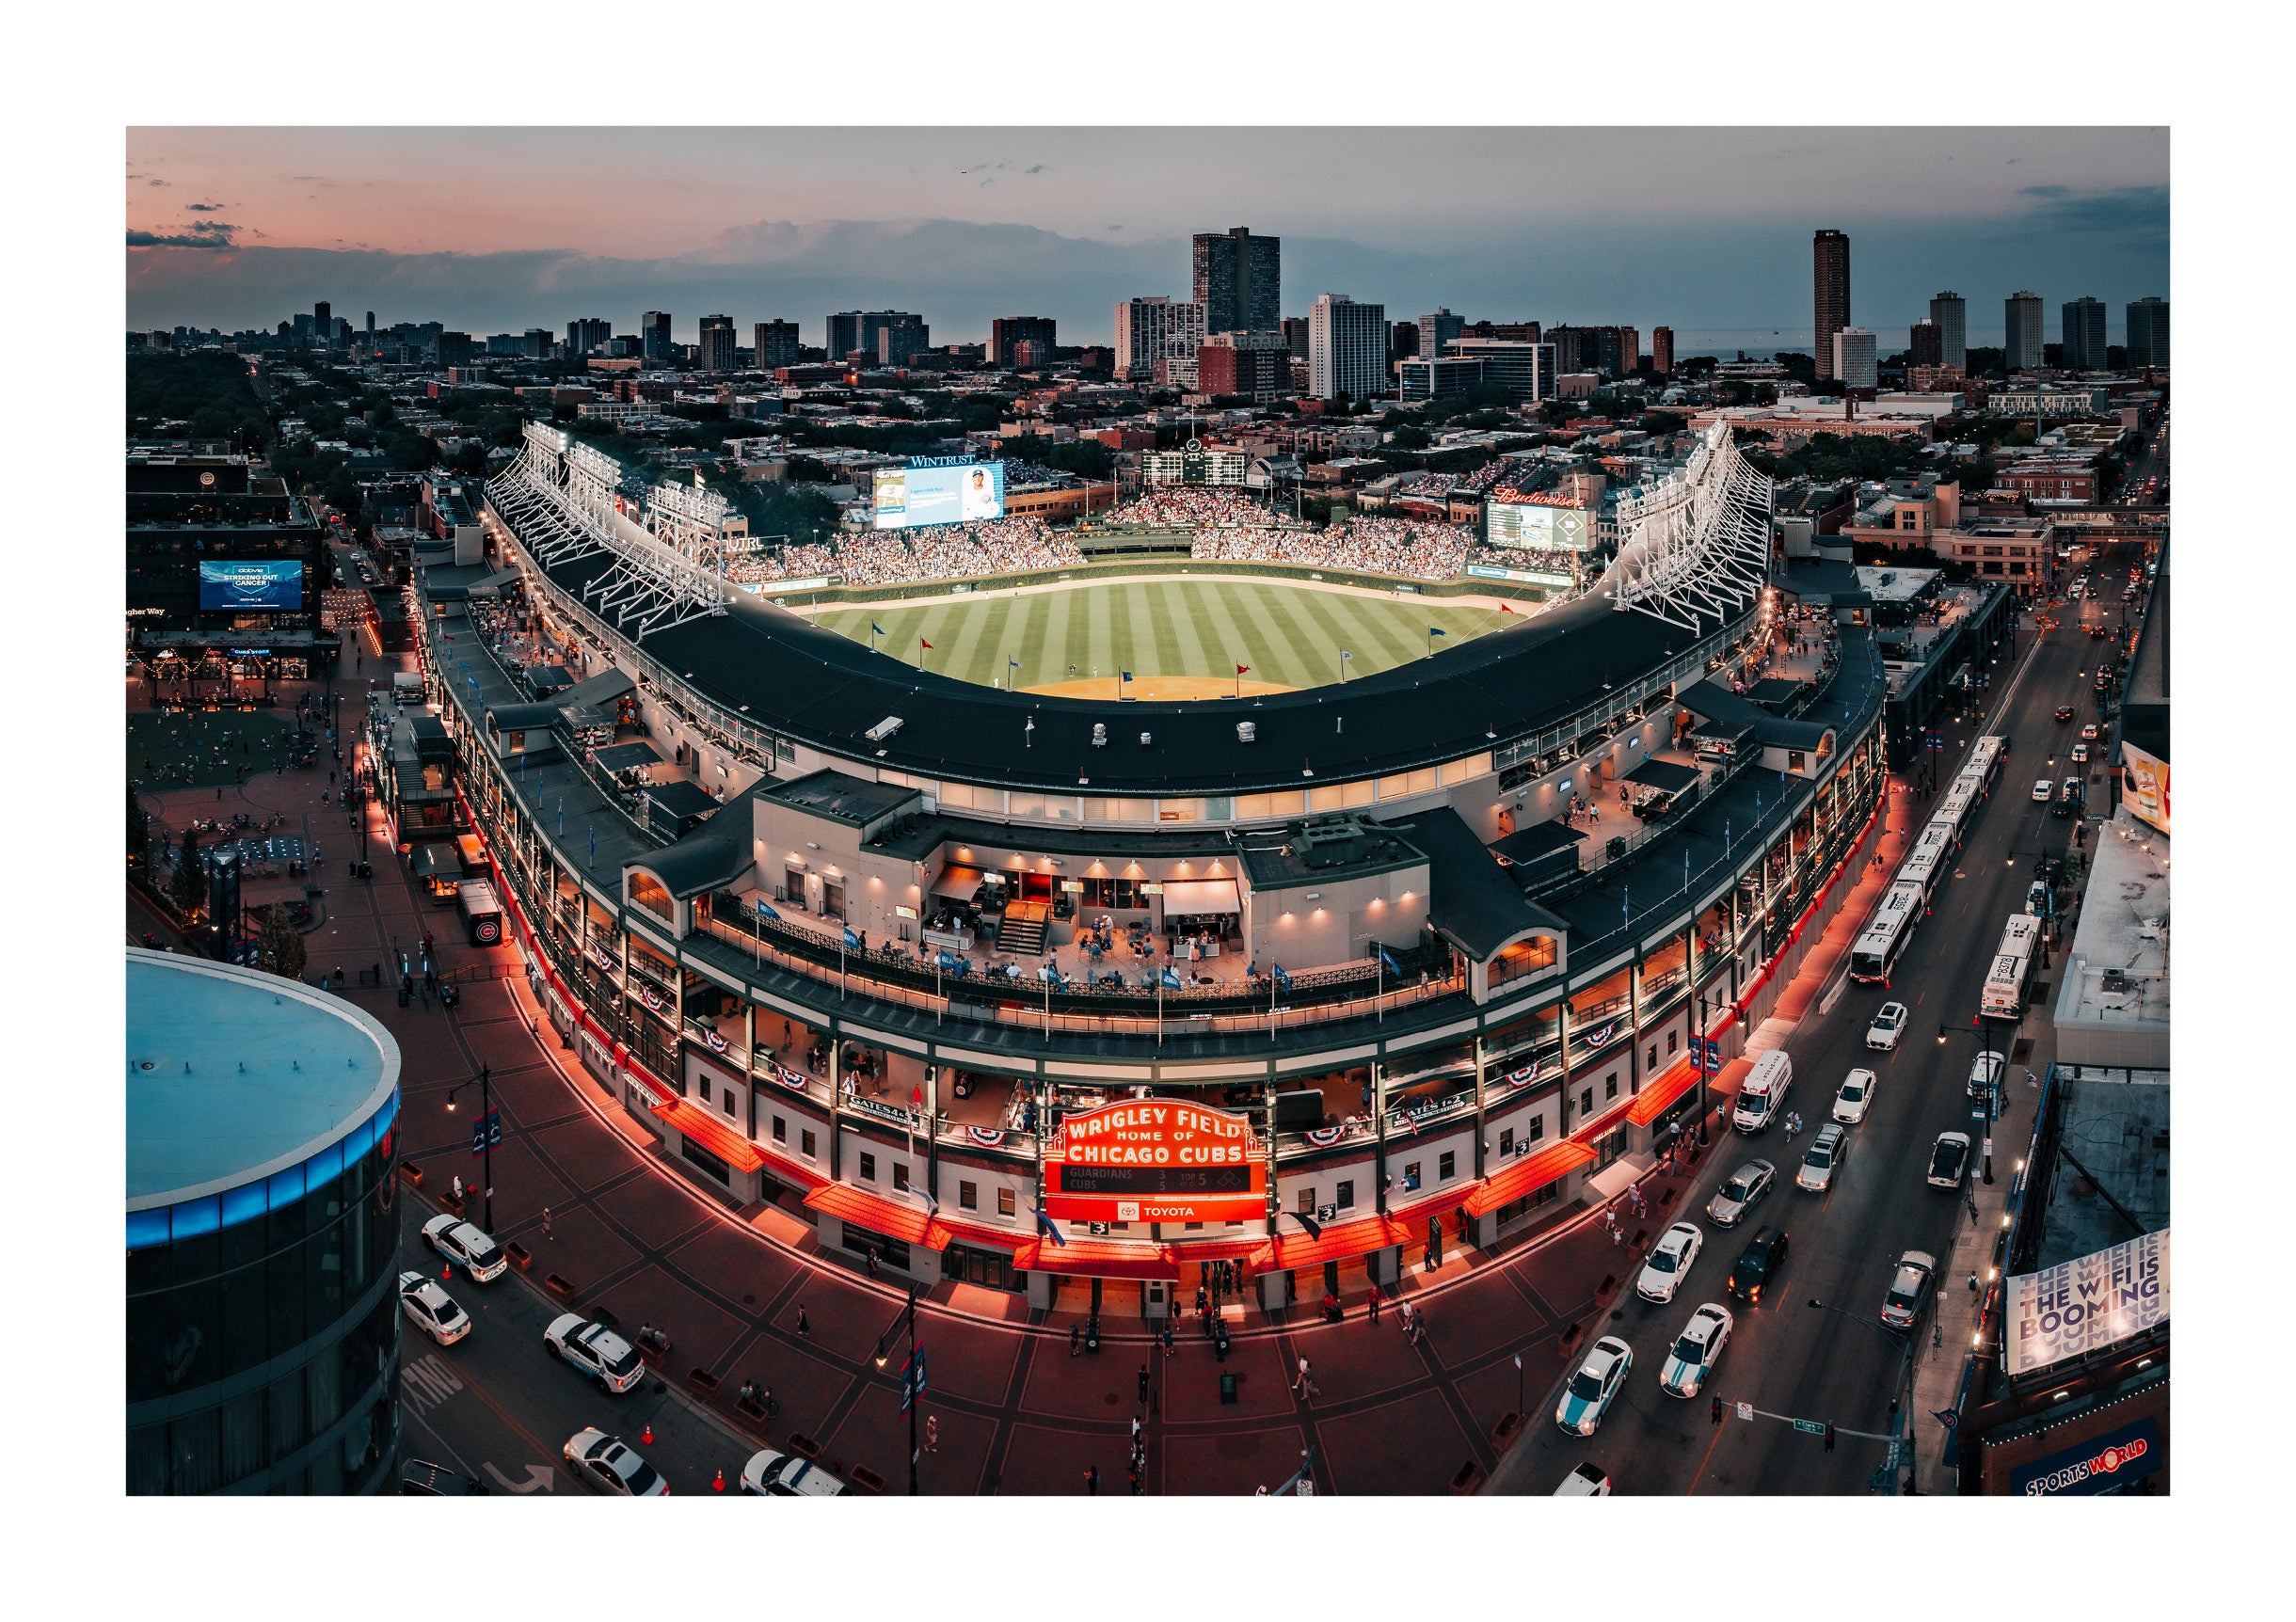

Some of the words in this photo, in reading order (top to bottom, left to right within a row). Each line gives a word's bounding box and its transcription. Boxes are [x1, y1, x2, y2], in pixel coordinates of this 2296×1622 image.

[1494, 487, 1585, 507] Budweiser
[851, 1095, 890, 1114] GATES
[1070, 1108, 1167, 1139] WRIGLEY
[1178, 1109, 1240, 1138] FIELD
[1118, 1131, 1162, 1140] HOME
[1174, 1131, 1194, 1140] OF
[1069, 1145, 1170, 1163] CHICAGO
[1180, 1146, 1242, 1163] CUBS
[1070, 1168, 1132, 1179] GUARDIANS
[1159, 1169, 1166, 1180] 3
[1199, 1172, 1206, 1185] 5
[1070, 1179, 1096, 1189] CUBS
[1159, 1181, 1166, 1191] 5
[1144, 1207, 1195, 1216] TOYOTA
[1321, 1208, 1332, 1218] 3
[1093, 1224, 1105, 1232] 3
[2020, 1287, 2070, 1318] THE
[2077, 1266, 2131, 1299] WIFI
[2140, 1257, 2160, 1280] IS
[2020, 1276, 2160, 1340] BOOMING
[401, 1354, 463, 1416] ONLY
[2025, 1461, 2089, 1496] SPORTS
[2087, 1439, 2147, 1475] WORLD
